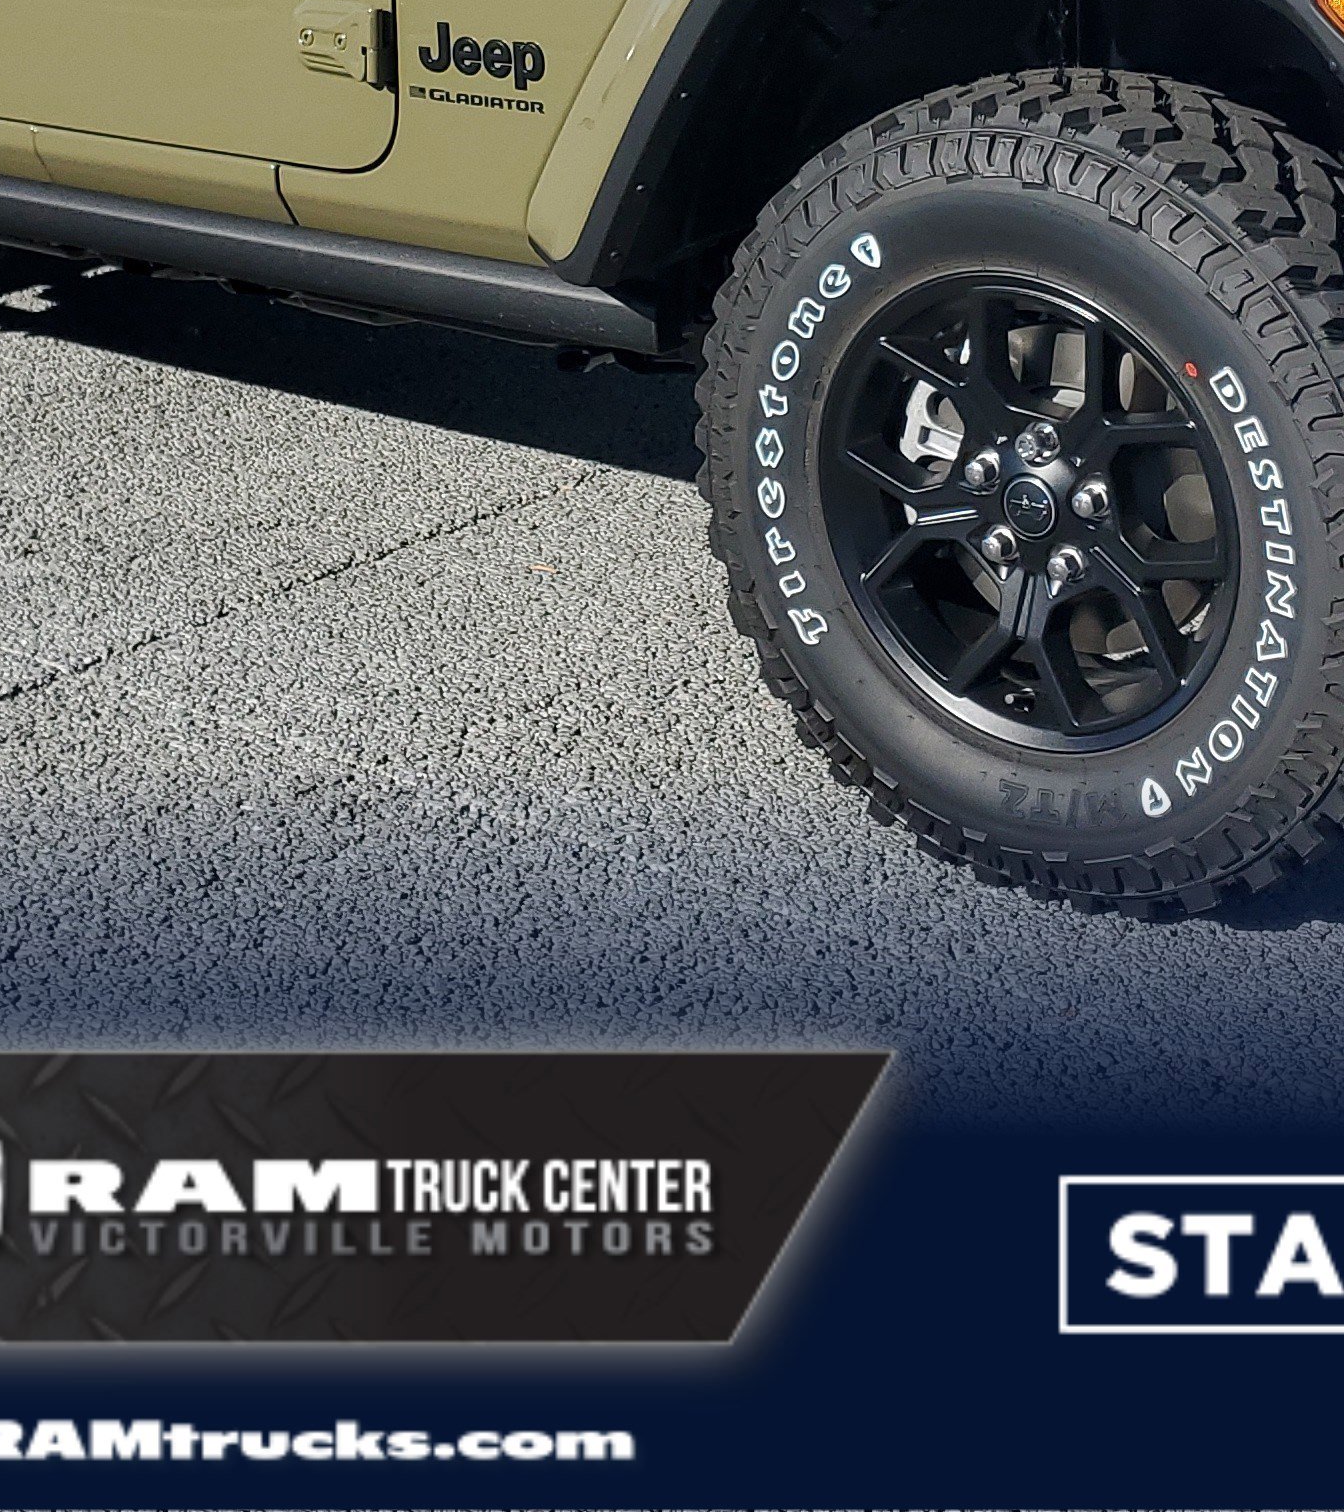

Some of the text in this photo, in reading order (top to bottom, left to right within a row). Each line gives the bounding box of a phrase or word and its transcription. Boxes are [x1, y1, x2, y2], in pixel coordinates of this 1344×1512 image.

[418, 22, 545, 90] Jeep
[428, 88, 545, 114] GLADIATOR
[755, 262, 853, 647] Firestone
[1175, 365, 1299, 799] DESTINATION
